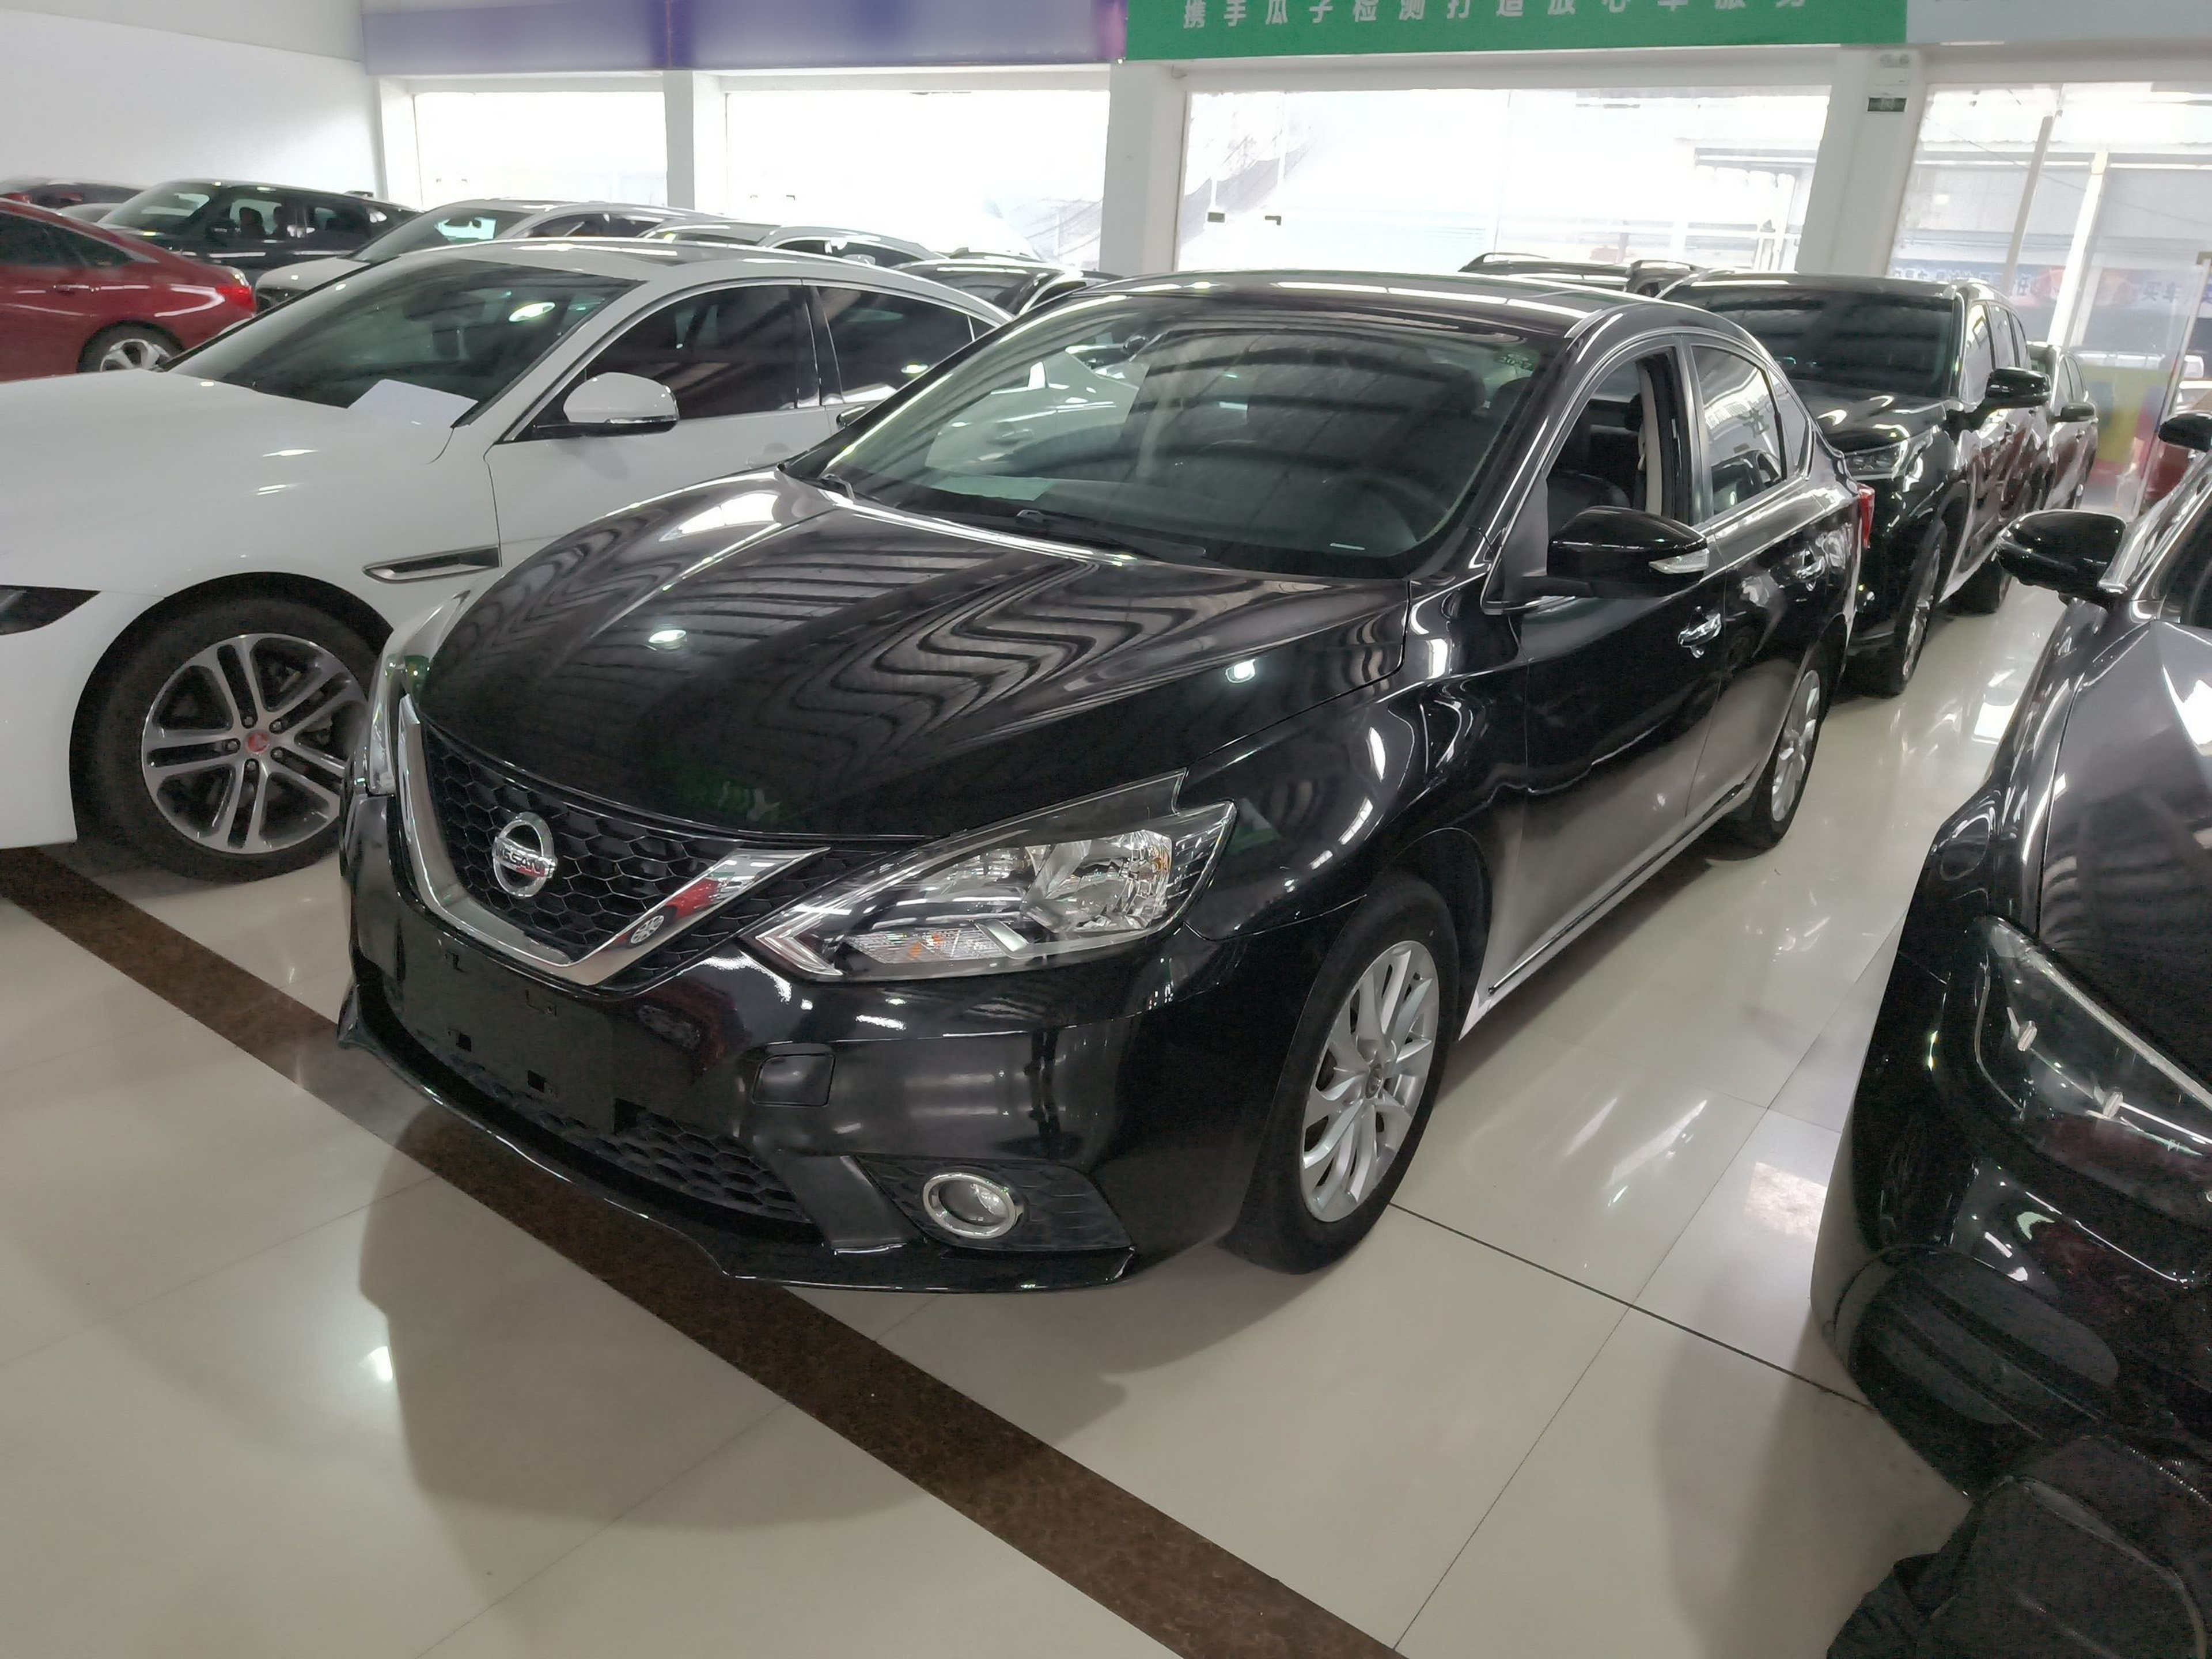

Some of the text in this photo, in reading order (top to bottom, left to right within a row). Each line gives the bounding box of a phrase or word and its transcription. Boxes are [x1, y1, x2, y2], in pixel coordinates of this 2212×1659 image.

[1183, 0, 1805, 28] 携手瓜子检测打造放
[495, 844, 546, 874] NISSAN
